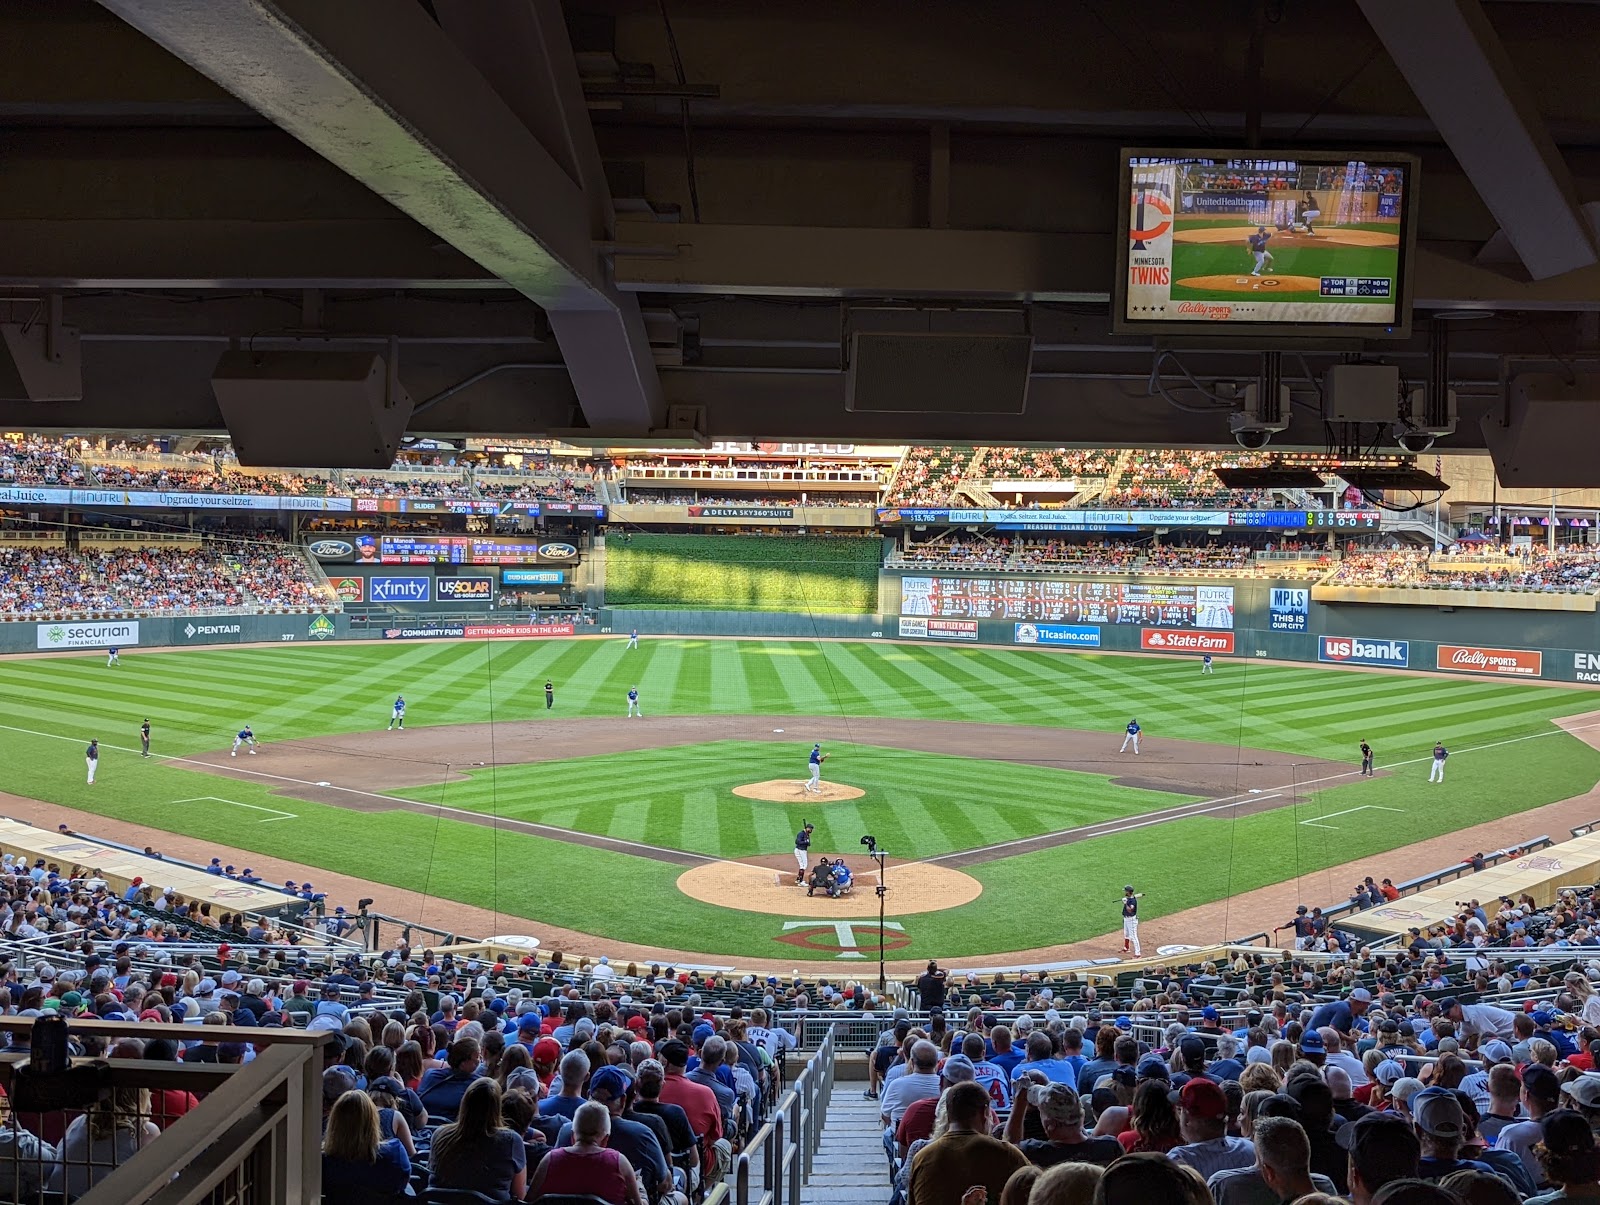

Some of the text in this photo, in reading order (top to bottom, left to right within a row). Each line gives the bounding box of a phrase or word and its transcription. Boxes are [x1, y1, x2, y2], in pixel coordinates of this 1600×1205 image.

[1134, 257, 1164, 265] MINNESOTA
[1130, 266, 1169, 284] TWINS
[1178, 302, 1208, 316] Bally
[13, 490, 47, 502] Juice.
[159, 494, 253, 508] Upgrade your seltzer.
[1149, 513, 1176, 522] Upgrade
[1193, 514, 1211, 522] seltzer.
[1366, 519, 1373, 527] 2
[317, 542, 344, 555] Ford
[545, 545, 569, 557] Ford
[374, 580, 426, 599] xfinity
[1274, 590, 1303, 606] MPLS
[1273, 614, 1304, 623] THIS IS
[198, 624, 241, 635] PENTAIR
[497, 627, 516, 635] MORE
[930, 621, 975, 631] TWINS FLEX PLANS
[68, 625, 130, 639] securian
[402, 629, 444, 637] COMMUNITY
[445, 628, 464, 636] FUND
[1452, 649, 1517, 668] Bally SPORTS
[327, 922, 338, 933] 20
[747, 1030, 770, 1038] EPLER
[974, 1066, 1000, 1077] CKETT
[989, 1080, 1005, 1107] 4
